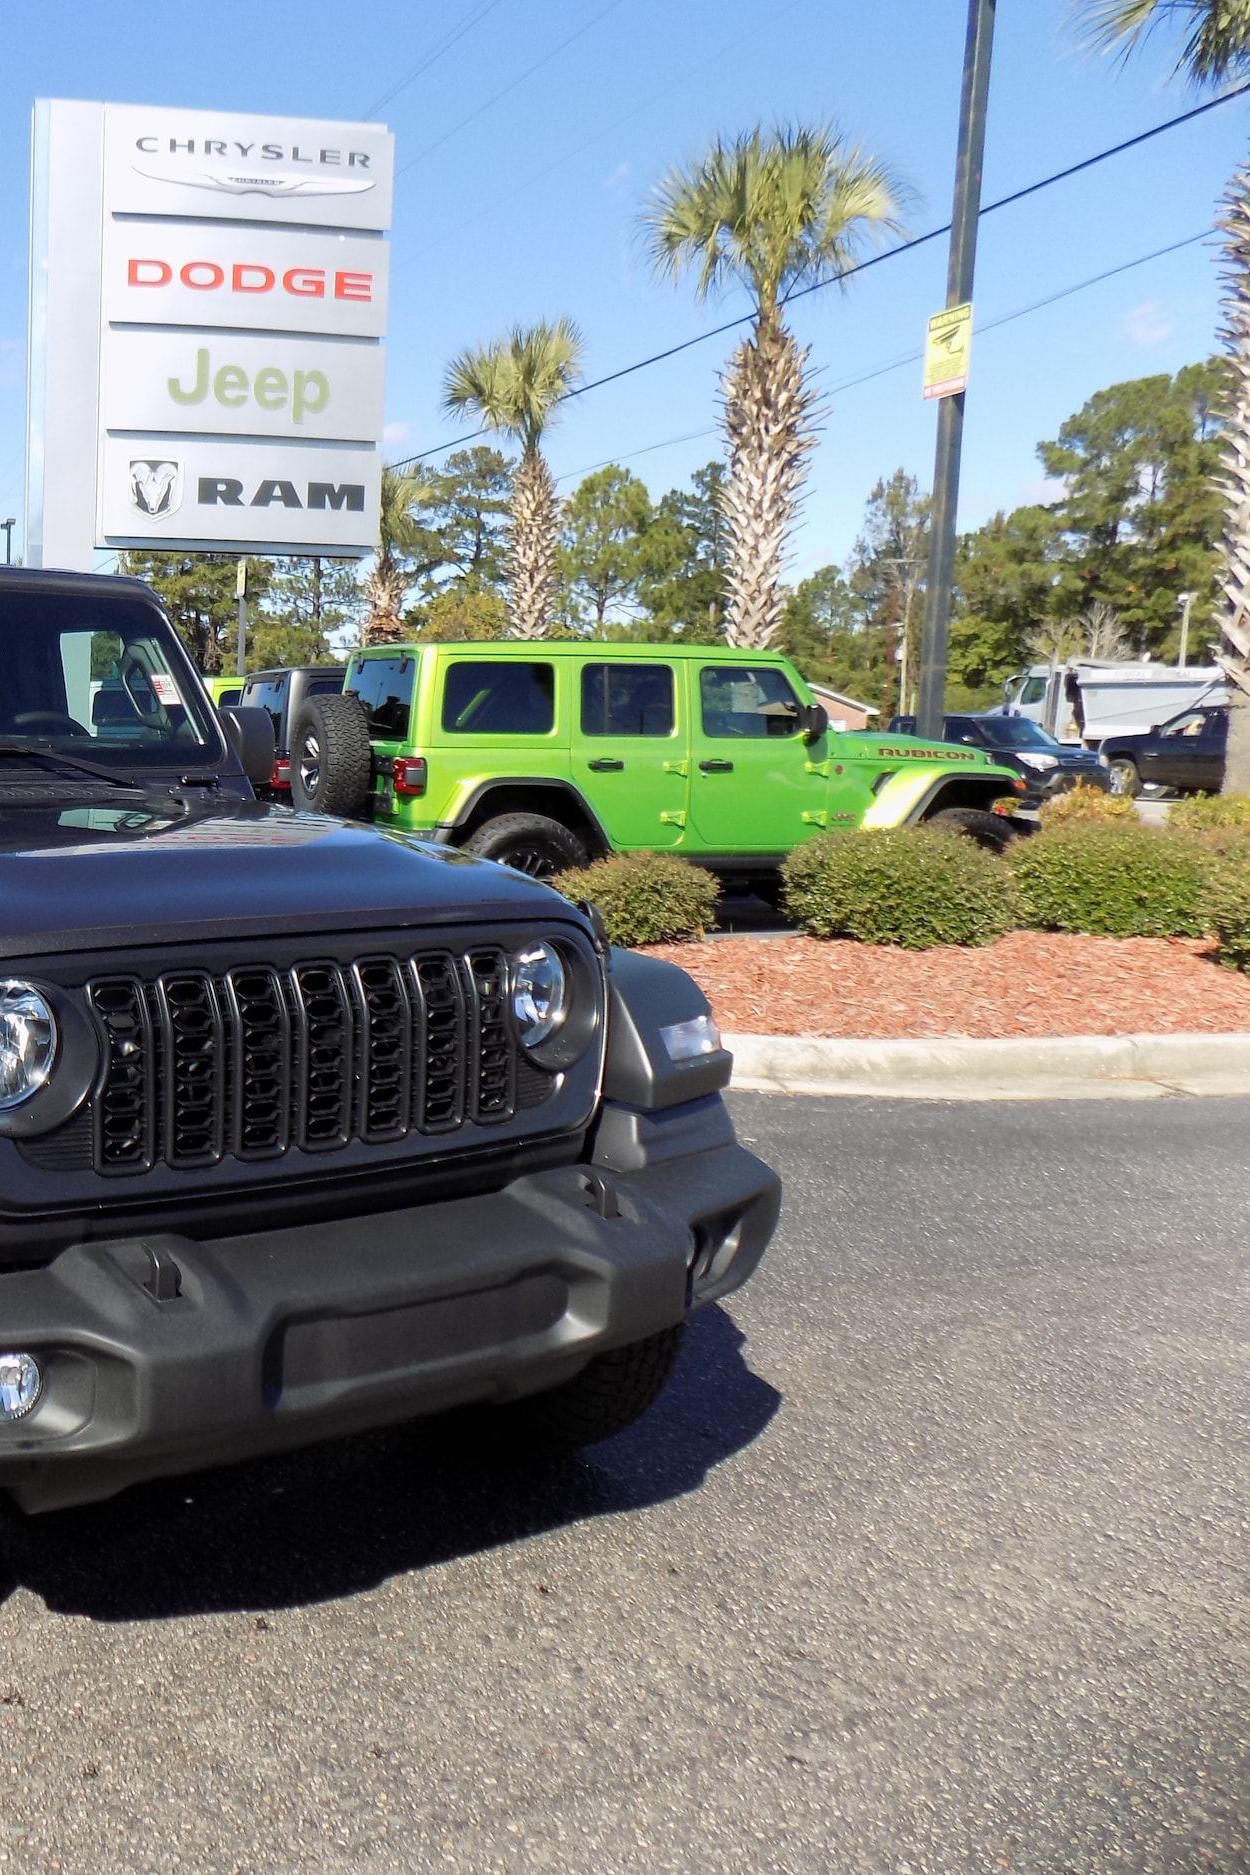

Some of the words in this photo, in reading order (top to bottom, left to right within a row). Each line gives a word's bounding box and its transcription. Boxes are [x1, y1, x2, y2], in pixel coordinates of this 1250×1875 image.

[135, 137, 371, 168] CHRYSLER
[128, 259, 374, 302] DODGE
[167, 347, 330, 424] Jeep
[197, 477, 365, 512] RAM
[877, 748, 976, 761] RUBICON
